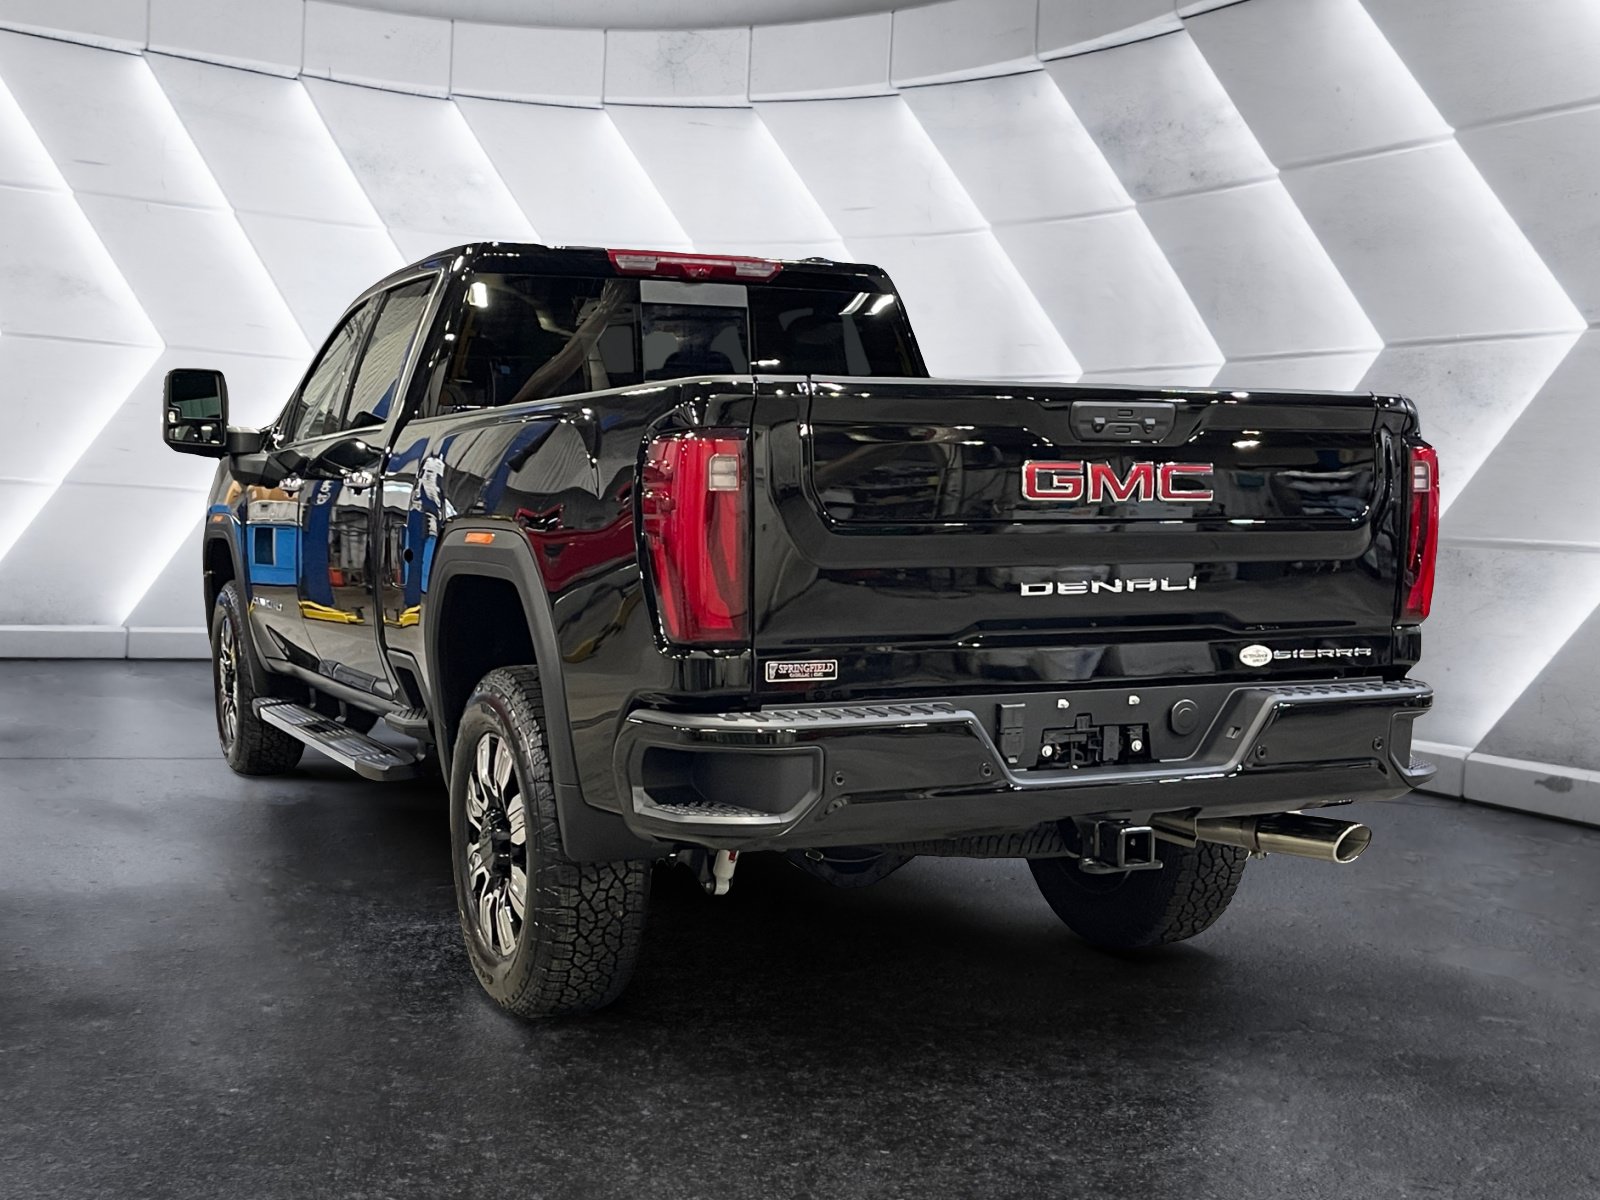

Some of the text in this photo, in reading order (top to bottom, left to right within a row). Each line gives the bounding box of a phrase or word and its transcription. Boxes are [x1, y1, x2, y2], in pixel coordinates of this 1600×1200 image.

[1022, 459, 1214, 503] GMC
[1020, 576, 1197, 597] DENALI
[1273, 647, 1372, 660] SIERRA
[778, 663, 834, 674] SPRINGFIELD
